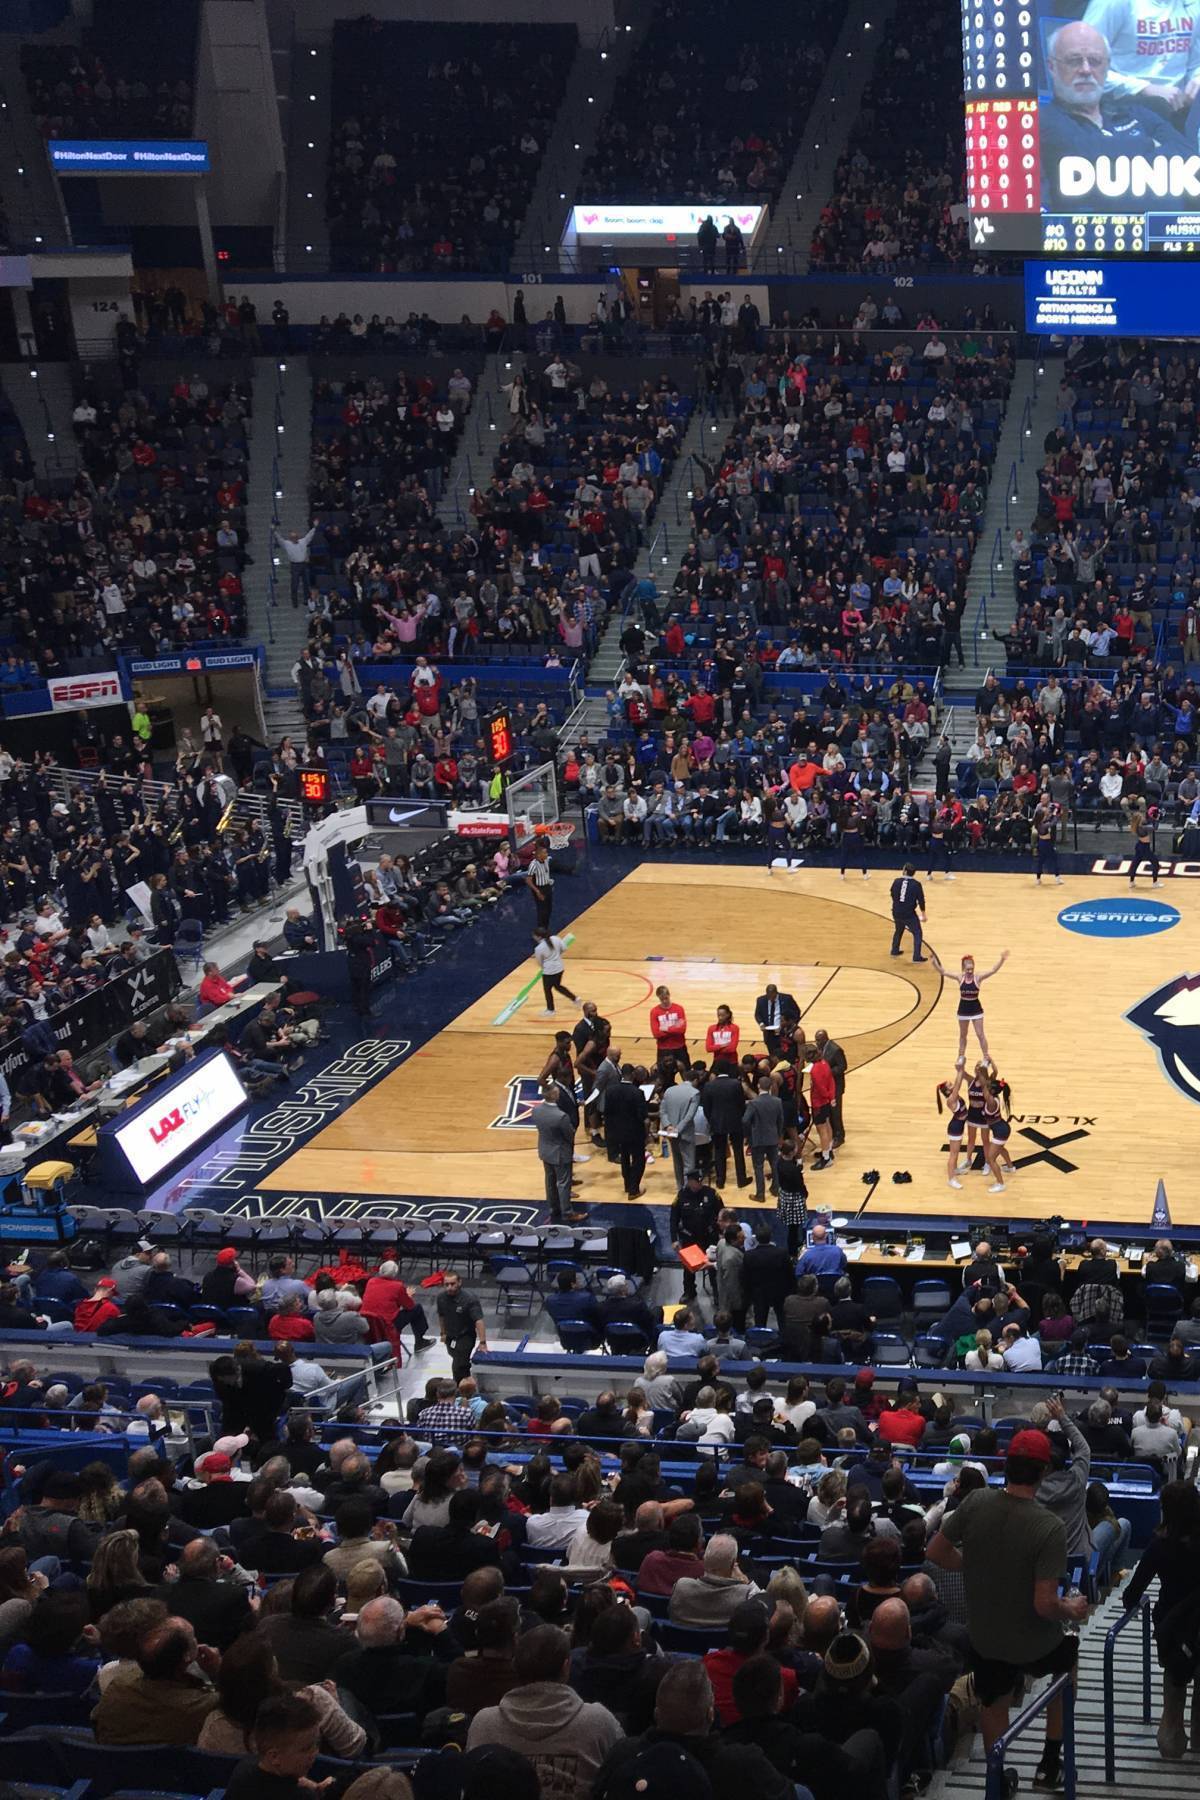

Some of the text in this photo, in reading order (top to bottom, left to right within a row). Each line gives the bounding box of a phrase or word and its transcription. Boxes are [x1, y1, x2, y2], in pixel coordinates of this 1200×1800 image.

[994, 11, 1030, 27] 0 0
[1136, 17, 1193, 34] BERLIN
[995, 32, 1029, 48] 0 1
[1136, 38, 1191, 56] SOCCER
[996, 52, 1032, 68] 2 0
[996, 73, 1030, 88] 0 1
[997, 114, 1033, 129] 0 0
[998, 134, 1034, 149] 0 0
[998, 154, 1035, 169] 0 0
[999, 174, 1033, 189] 0 1
[1002, 193, 1033, 209] 1 1
[974, 216, 994, 243] XL
[521, 273, 542, 284] 101
[893, 276, 914, 287] 102
[1045, 270, 1103, 285] UCONN
[1052, 286, 1097, 295] HEALTH
[133, 660, 180, 671] BUD LIGHT
[207, 654, 253, 666] BUD LIGHT
[53, 680, 117, 702] ESPN
[492, 731, 507, 760] 30
[305, 783, 321, 797] 30
[127, 967, 156, 1007] XL
[178, 1039, 412, 1190] HUSKIES
[149, 1107, 185, 1144] LAZ
